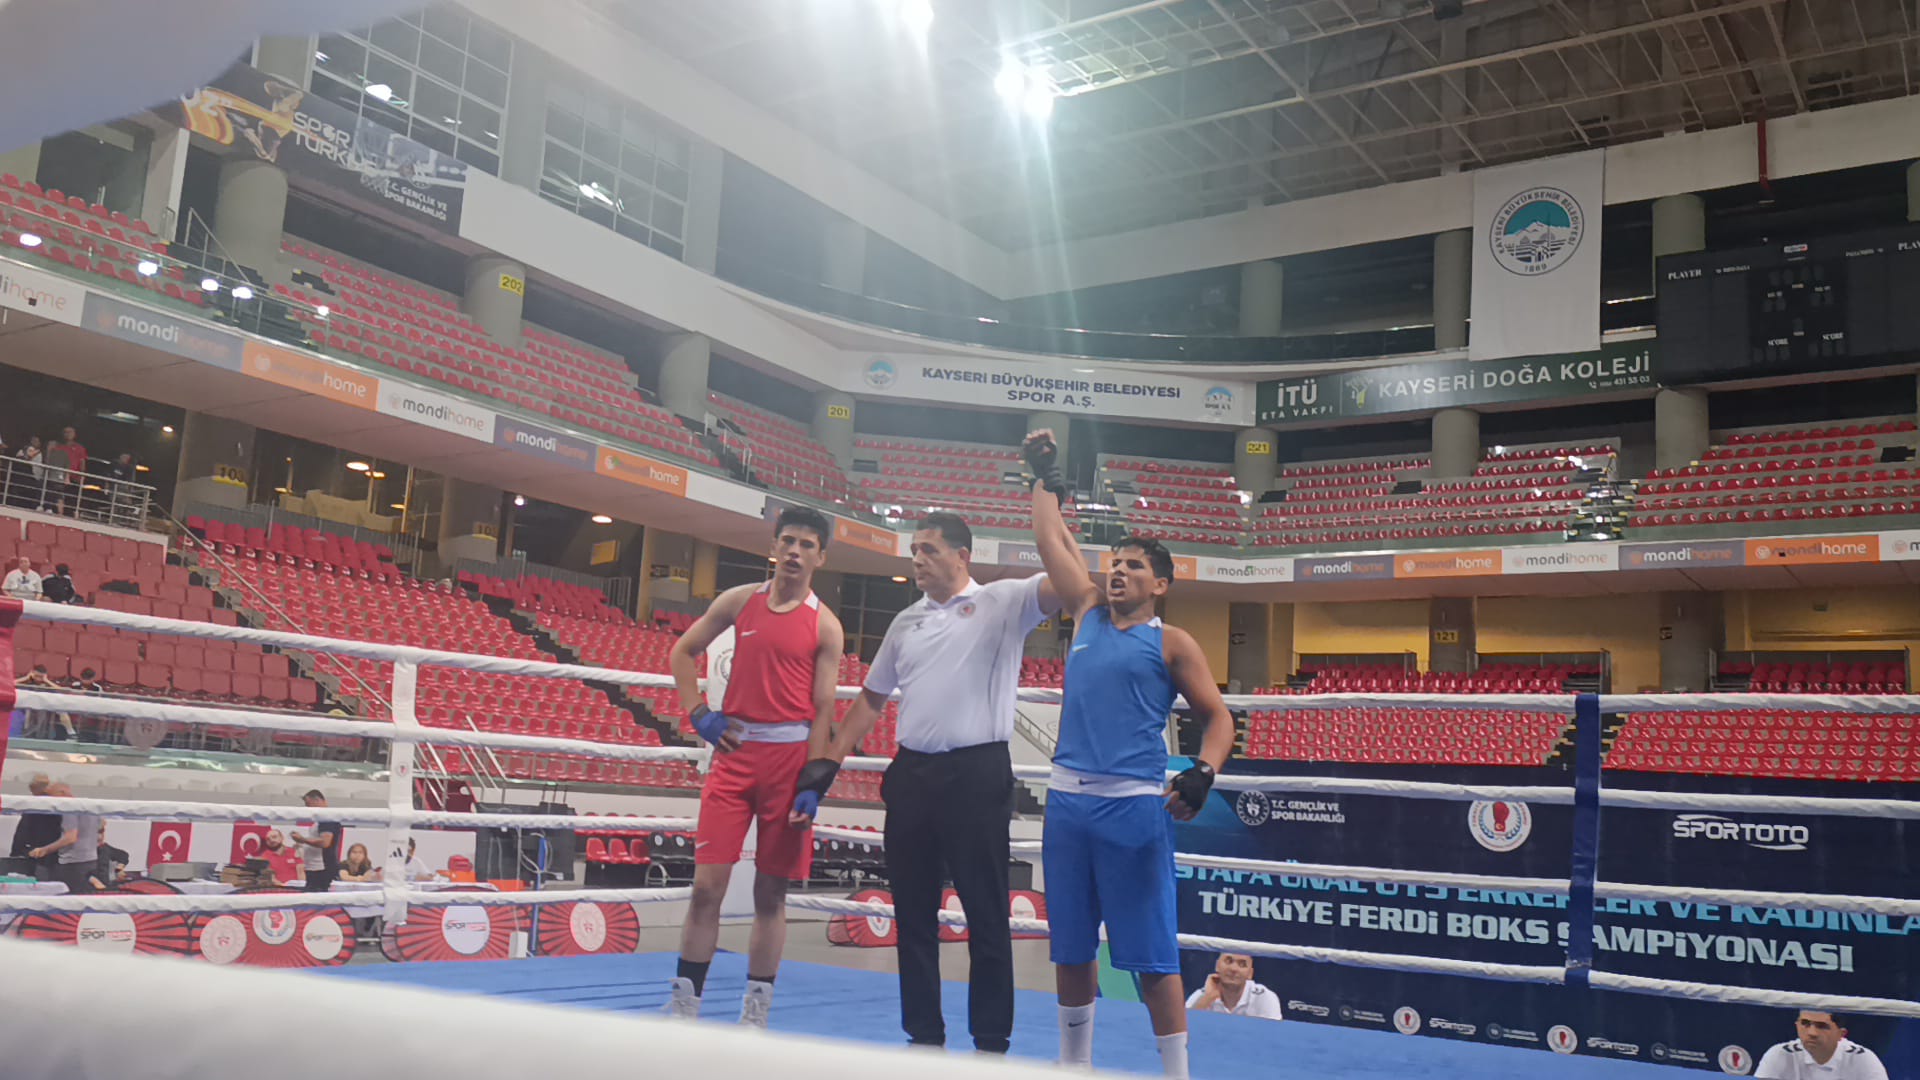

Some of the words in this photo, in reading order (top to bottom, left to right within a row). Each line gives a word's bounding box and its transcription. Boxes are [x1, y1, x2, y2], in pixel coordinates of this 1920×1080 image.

[1668, 269, 1702, 280] PLAYER
[502, 276, 522, 293] 202
[1379, 369, 1475, 398] KAYSERİ
[1483, 364, 1552, 389] DOĞA
[1560, 351, 1651, 381] KOLEJİ
[922, 367, 987, 384] KAYSERİ
[991, 372, 1090, 392] BÜYÜKŞEHİR
[1093, 382, 1180, 398] BELEDİYESİ
[1007, 390, 1055, 404] SPOR
[1062, 395, 1095, 408] A.Ş.
[1277, 378, 1318, 408] İTÜ
[402, 398, 486, 432] mondihome
[830, 406, 848, 417] 201
[1261, 410, 1285, 420] ETA
[1526, 553, 1607, 567] mondihome
[1436, 631, 1455, 641] 121
[1288, 800, 1325, 814] GENÇLİK
[1326, 802, 1340, 812] VE
[1271, 811, 1294, 822] SPOR
[1296, 812, 1346, 824] BAKANLIĞI
[1447, 911, 1550, 945] BOKS
